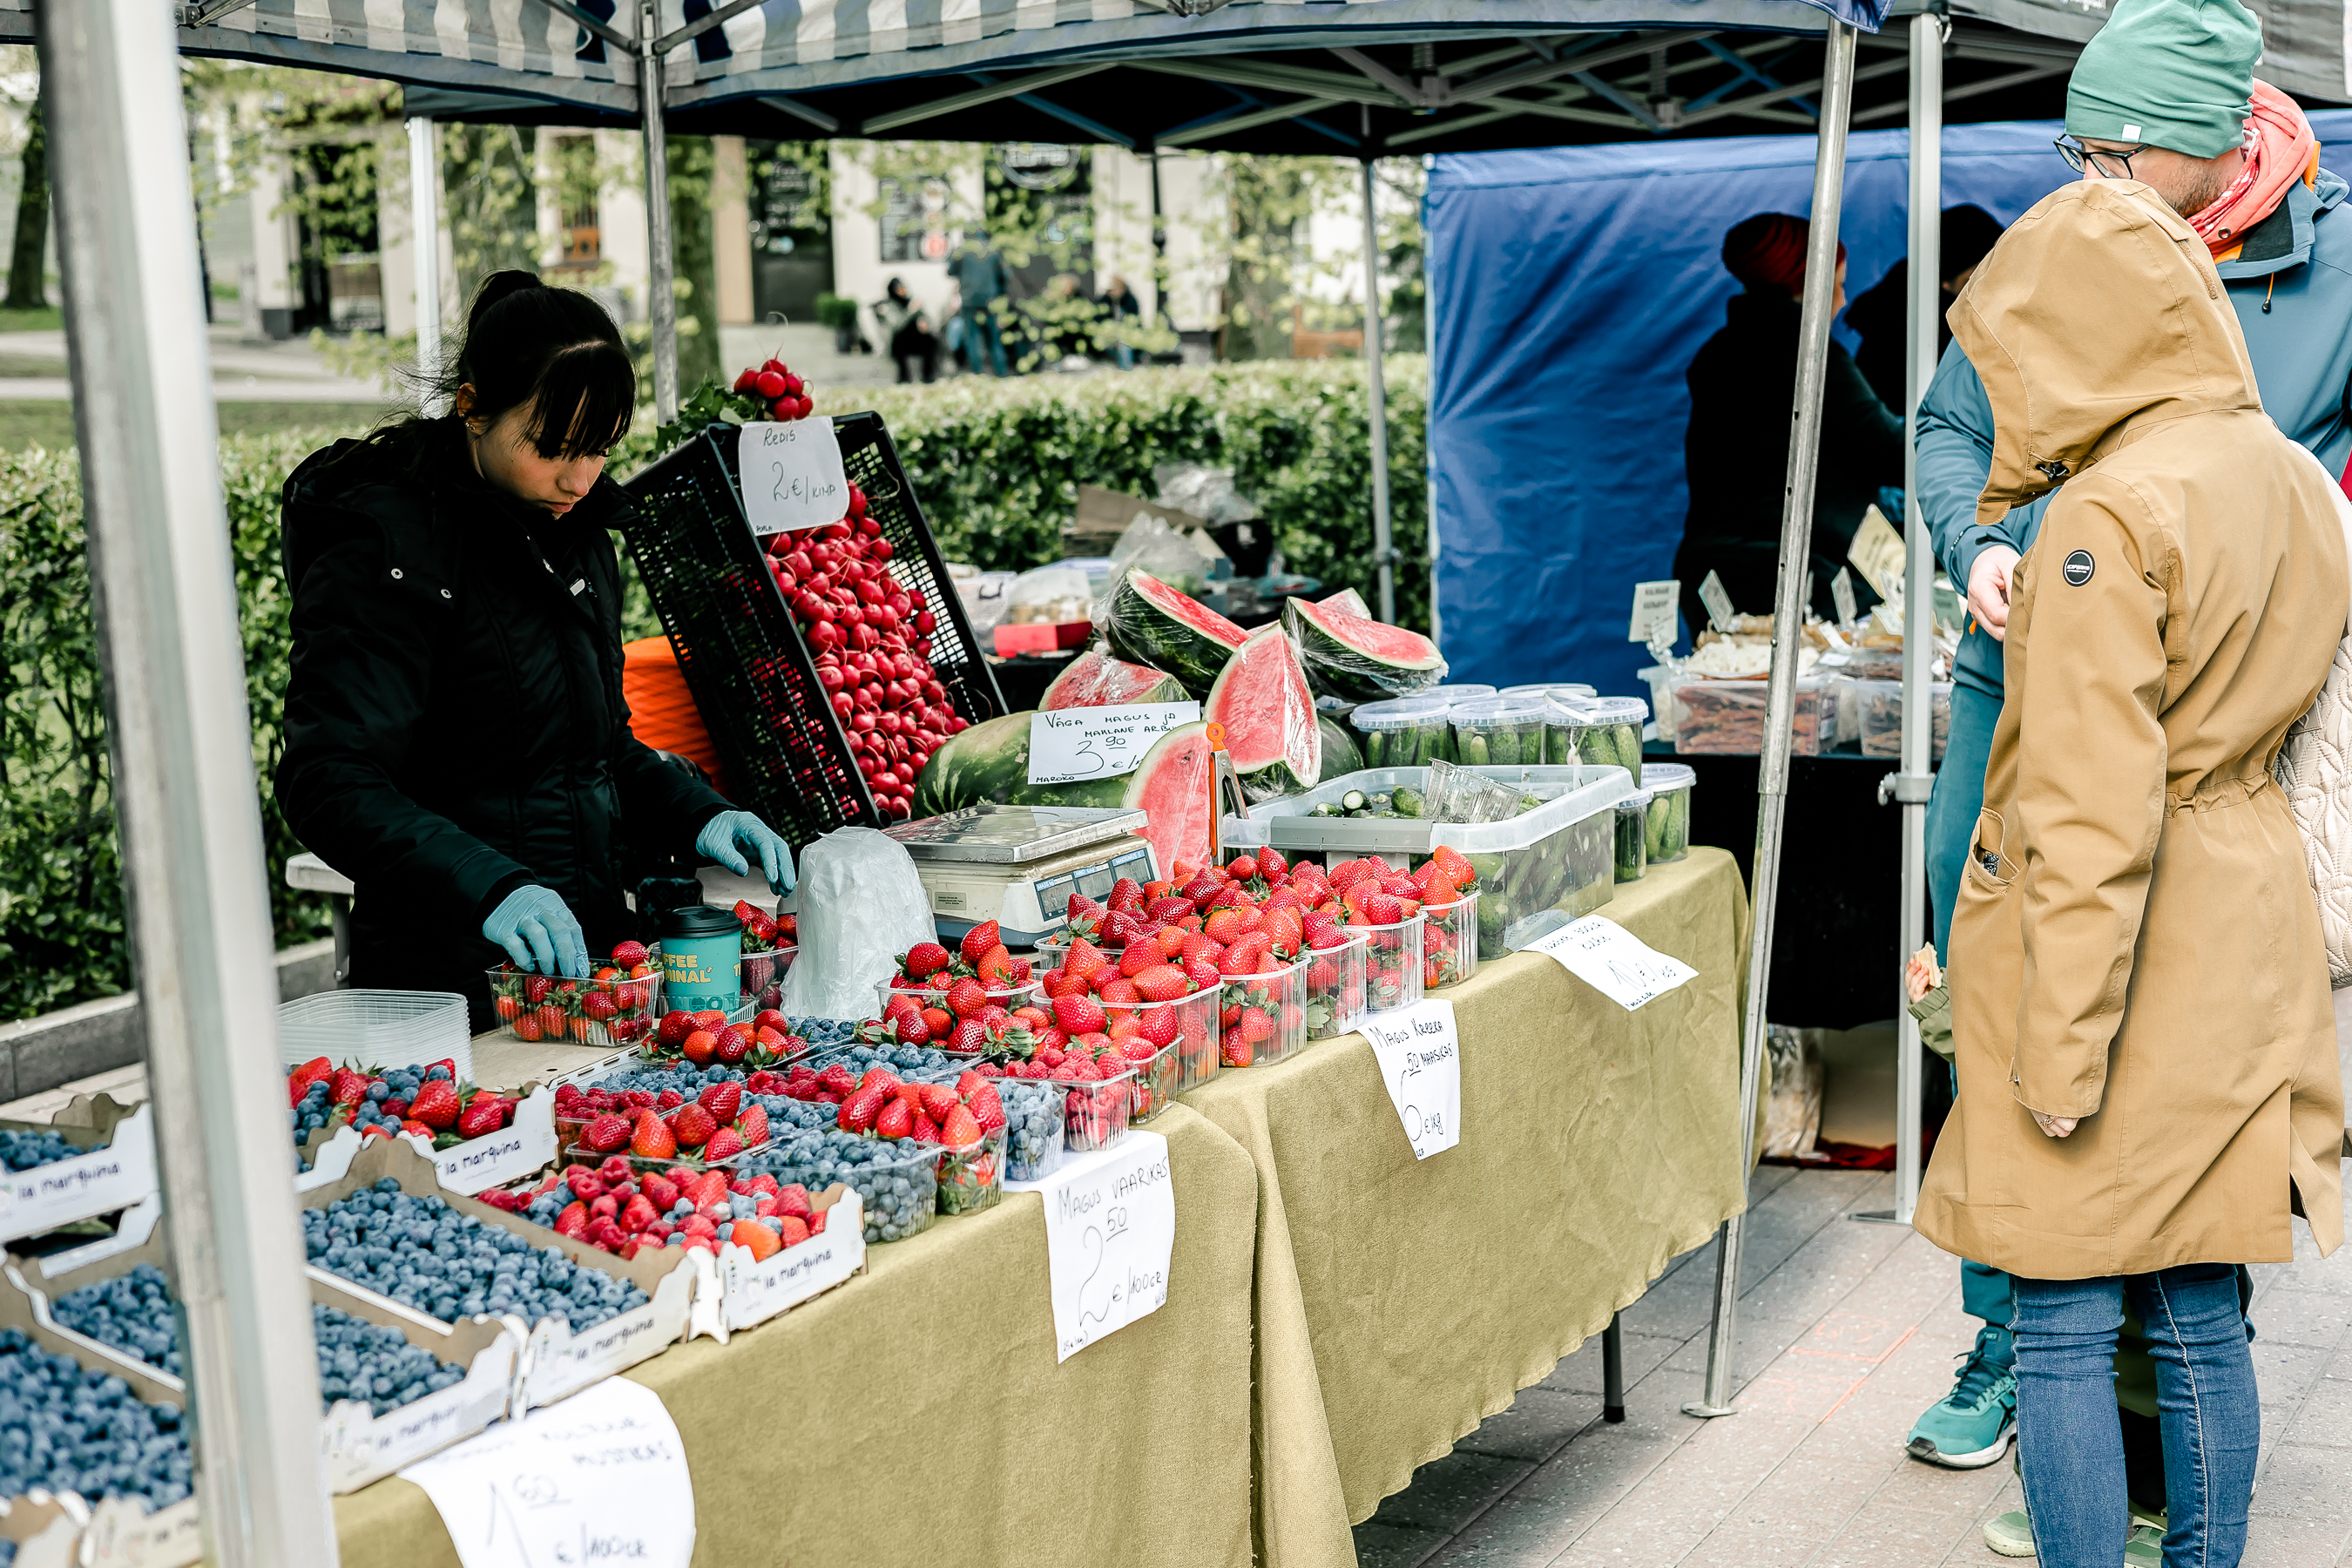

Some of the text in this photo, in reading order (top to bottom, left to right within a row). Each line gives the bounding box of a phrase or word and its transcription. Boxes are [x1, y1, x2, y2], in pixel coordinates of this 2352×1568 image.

[1045, 713, 1084, 728] VÄGA
[1105, 713, 1151, 724] MAGUS
[1061, 740, 1105, 776] 3
[1105, 735, 1126, 747] 90
[1036, 774, 1075, 783] MAROKO
[1369, 1025, 1409, 1048] MAGUS
[1406, 1051, 1420, 1072] 50
[445, 1163, 457, 1175] la
[462, 1139, 521, 1167] marquina
[1058, 1186, 1101, 1225] MAGUS
[765, 1275, 776, 1290] la
[780, 1248, 832, 1280] marquina
[1078, 1226, 1110, 1328] 2
[1107, 1206, 1127, 1232] 50
[400, 1402, 459, 1436] marquin
